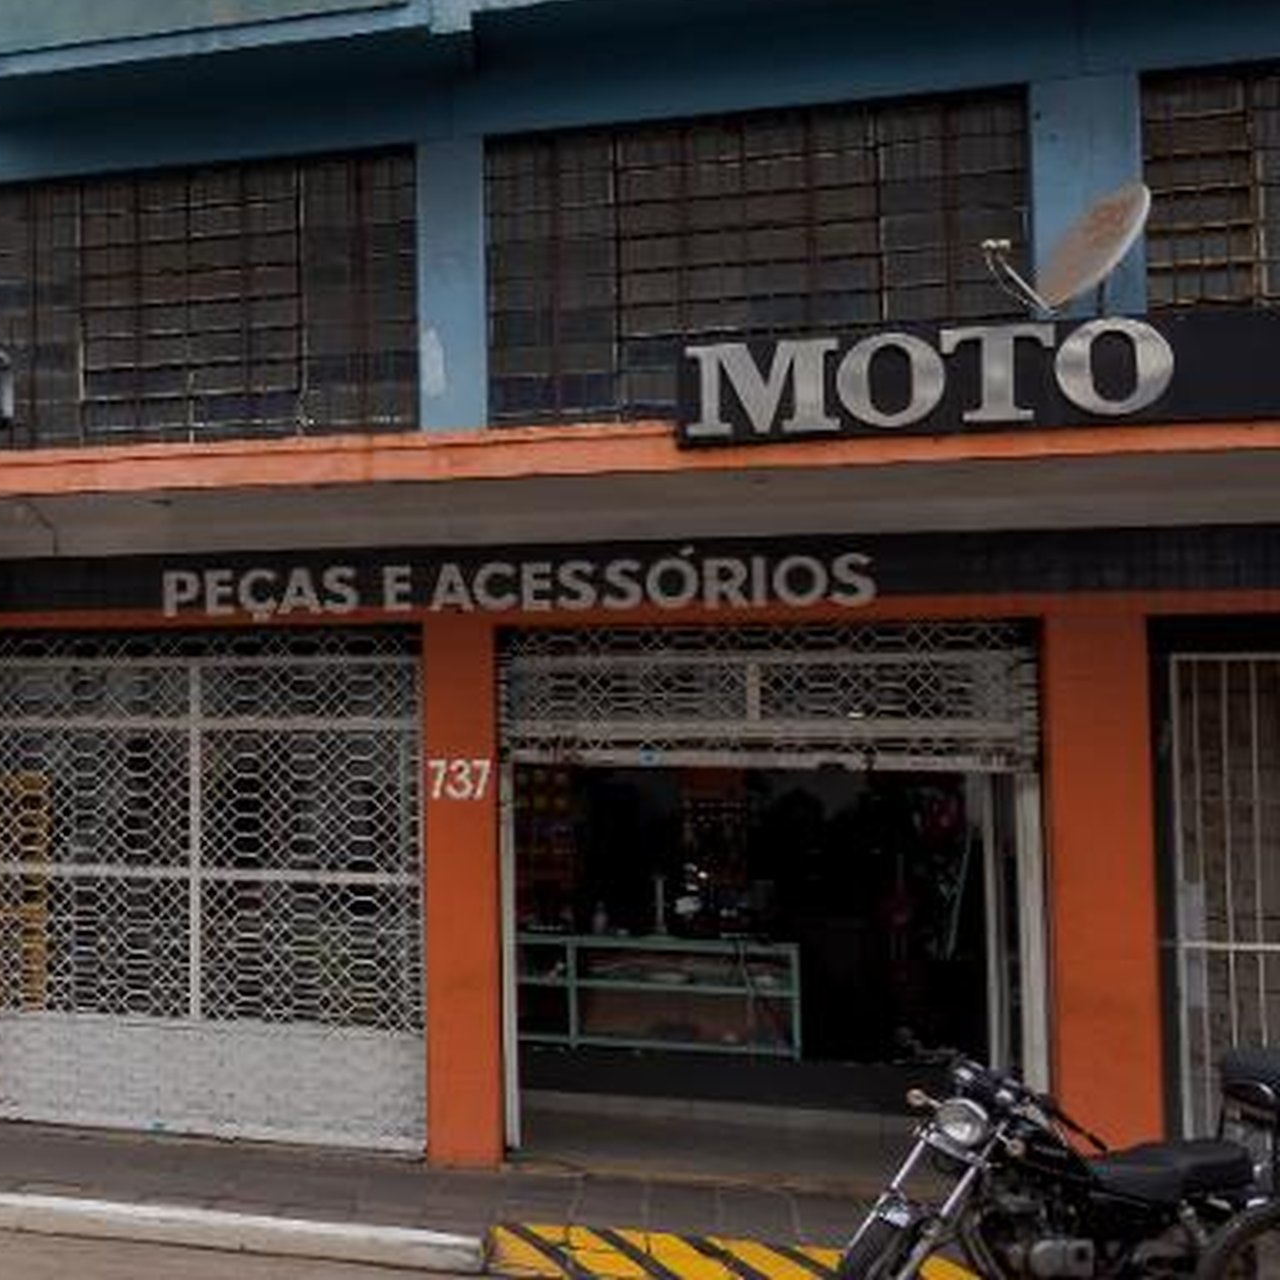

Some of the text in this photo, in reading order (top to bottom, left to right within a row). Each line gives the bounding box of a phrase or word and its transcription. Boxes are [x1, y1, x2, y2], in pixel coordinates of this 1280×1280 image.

[685, 317, 1175, 437] MOTO
[162, 545, 877, 624] PEÇAS E ACESSÓRIOS
[428, 759, 491, 799] 737
